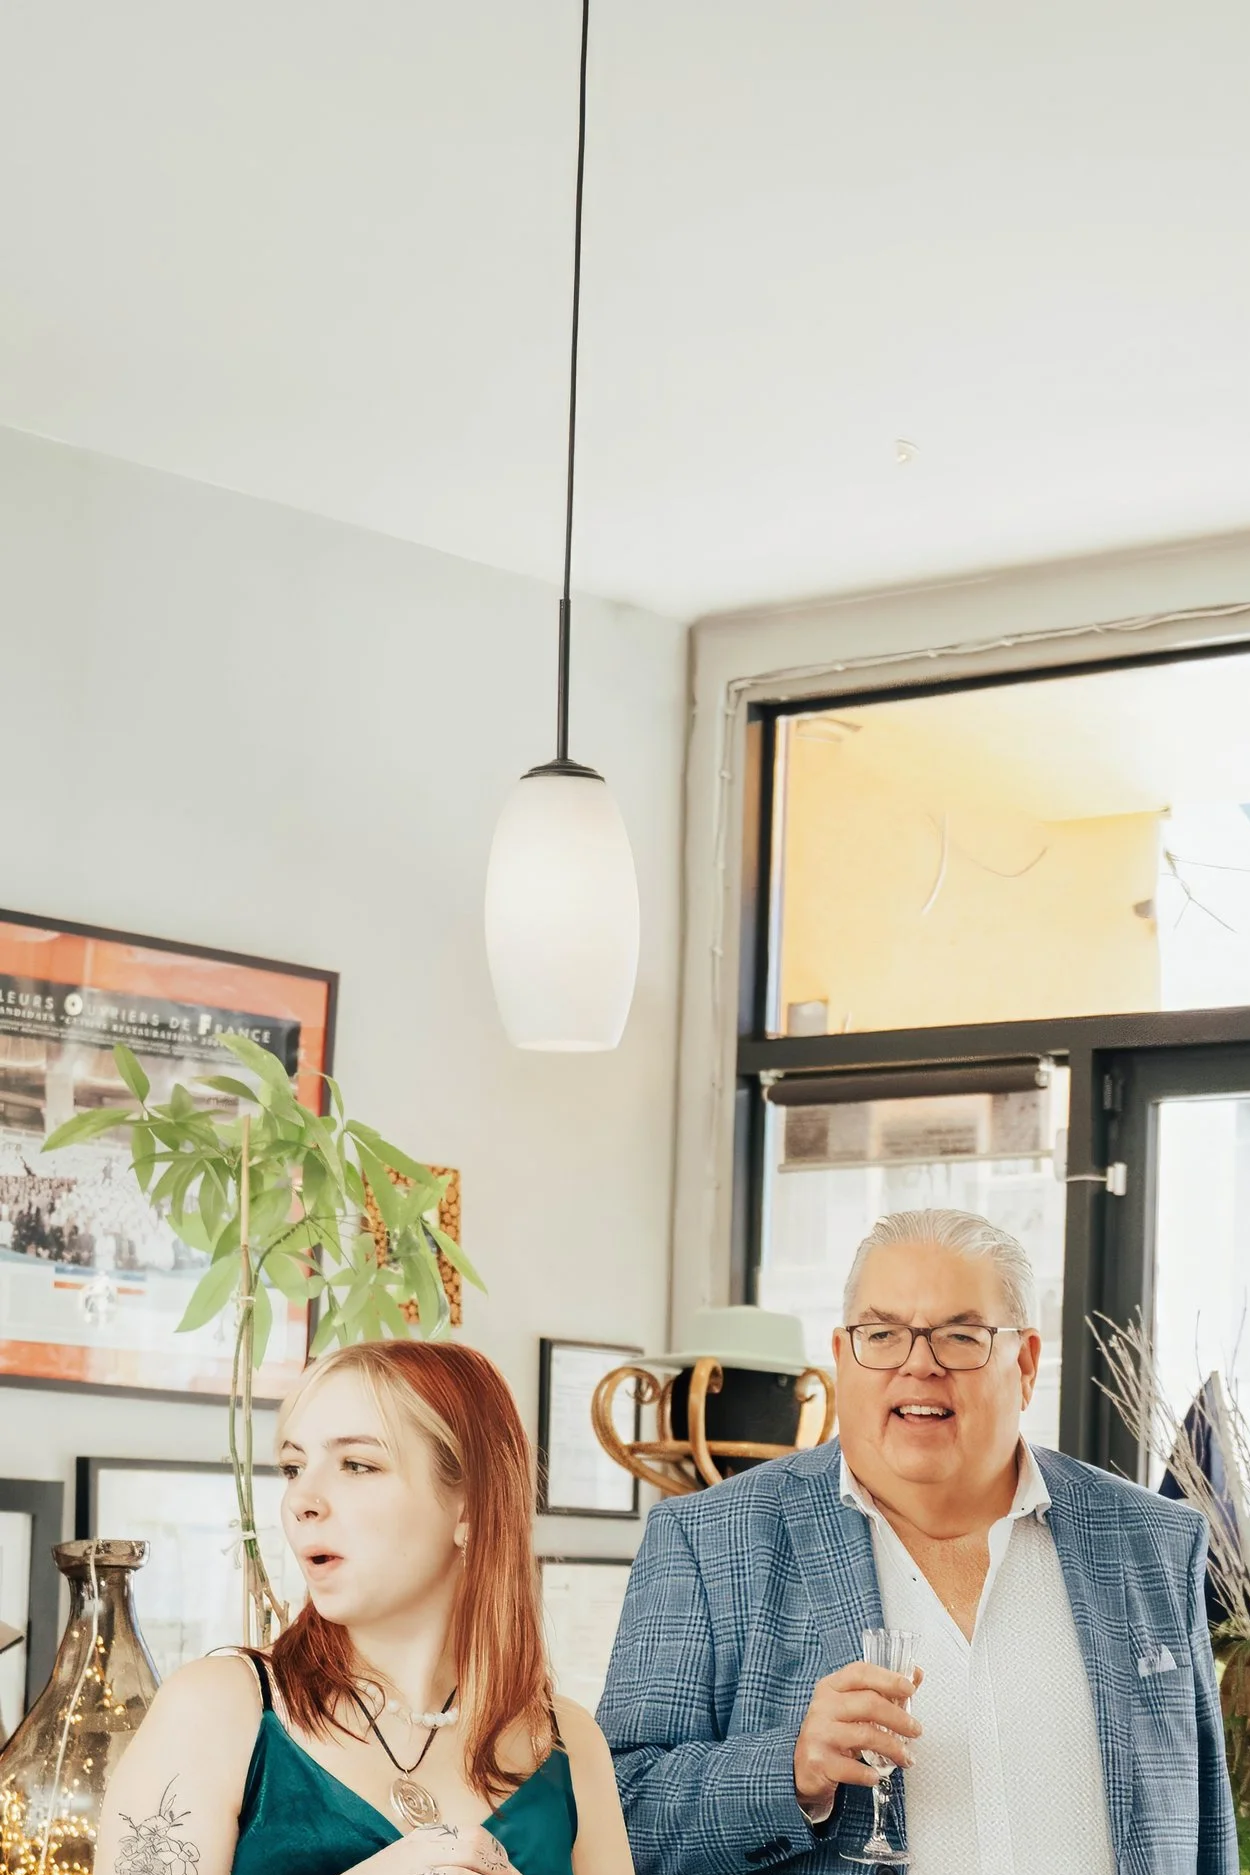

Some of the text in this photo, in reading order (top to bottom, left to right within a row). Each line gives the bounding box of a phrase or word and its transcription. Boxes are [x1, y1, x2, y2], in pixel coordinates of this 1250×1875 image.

[64, 992, 159, 1027] OUVRIERS
[168, 1016, 190, 1032] DE
[197, 1013, 271, 1044] FRANCE
